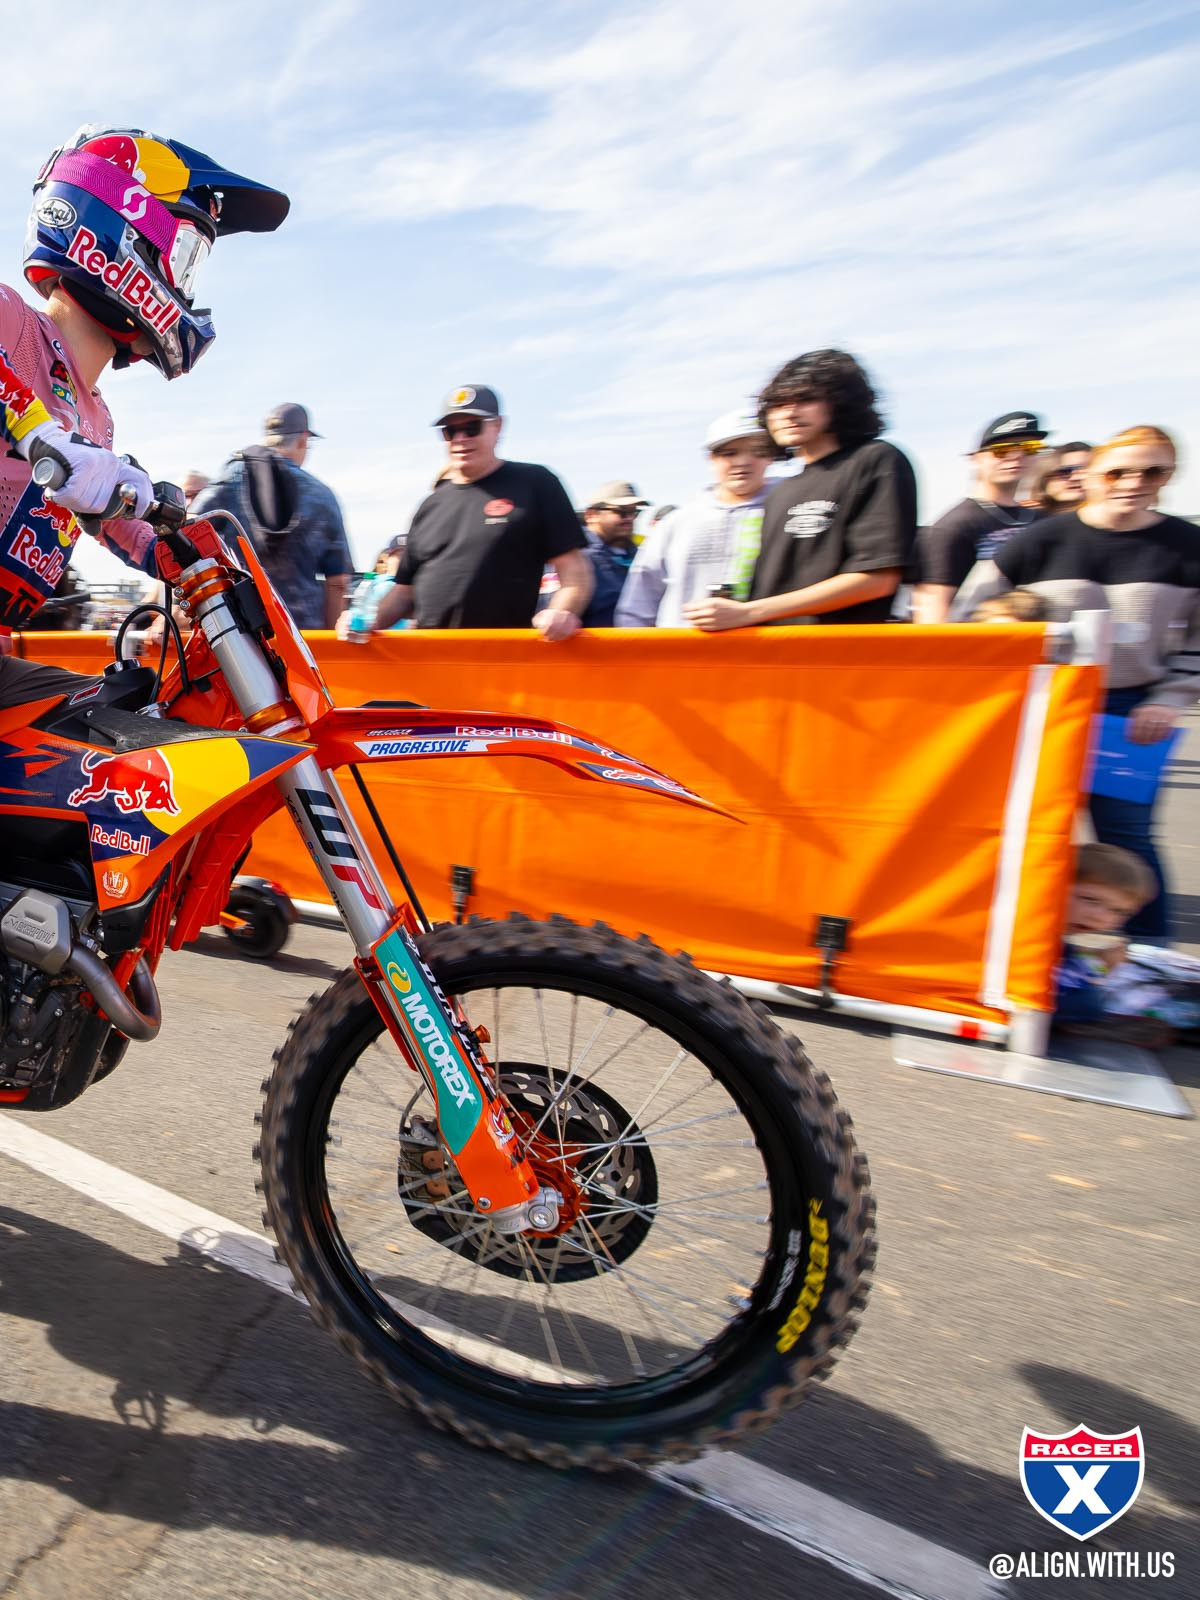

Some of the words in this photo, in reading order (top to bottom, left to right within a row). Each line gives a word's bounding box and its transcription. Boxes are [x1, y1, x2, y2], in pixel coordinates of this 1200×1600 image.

[65, 225, 136, 296] Red
[120, 267, 183, 337] Bull
[7, 523, 59, 577] Red
[368, 740, 471, 756] PROGRESSIVE
[455, 726, 513, 737] Red
[514, 727, 573, 745] Bull
[91, 823, 120, 849] Red
[118, 830, 151, 857] Bull
[400, 990, 477, 1110] MOTOREX
